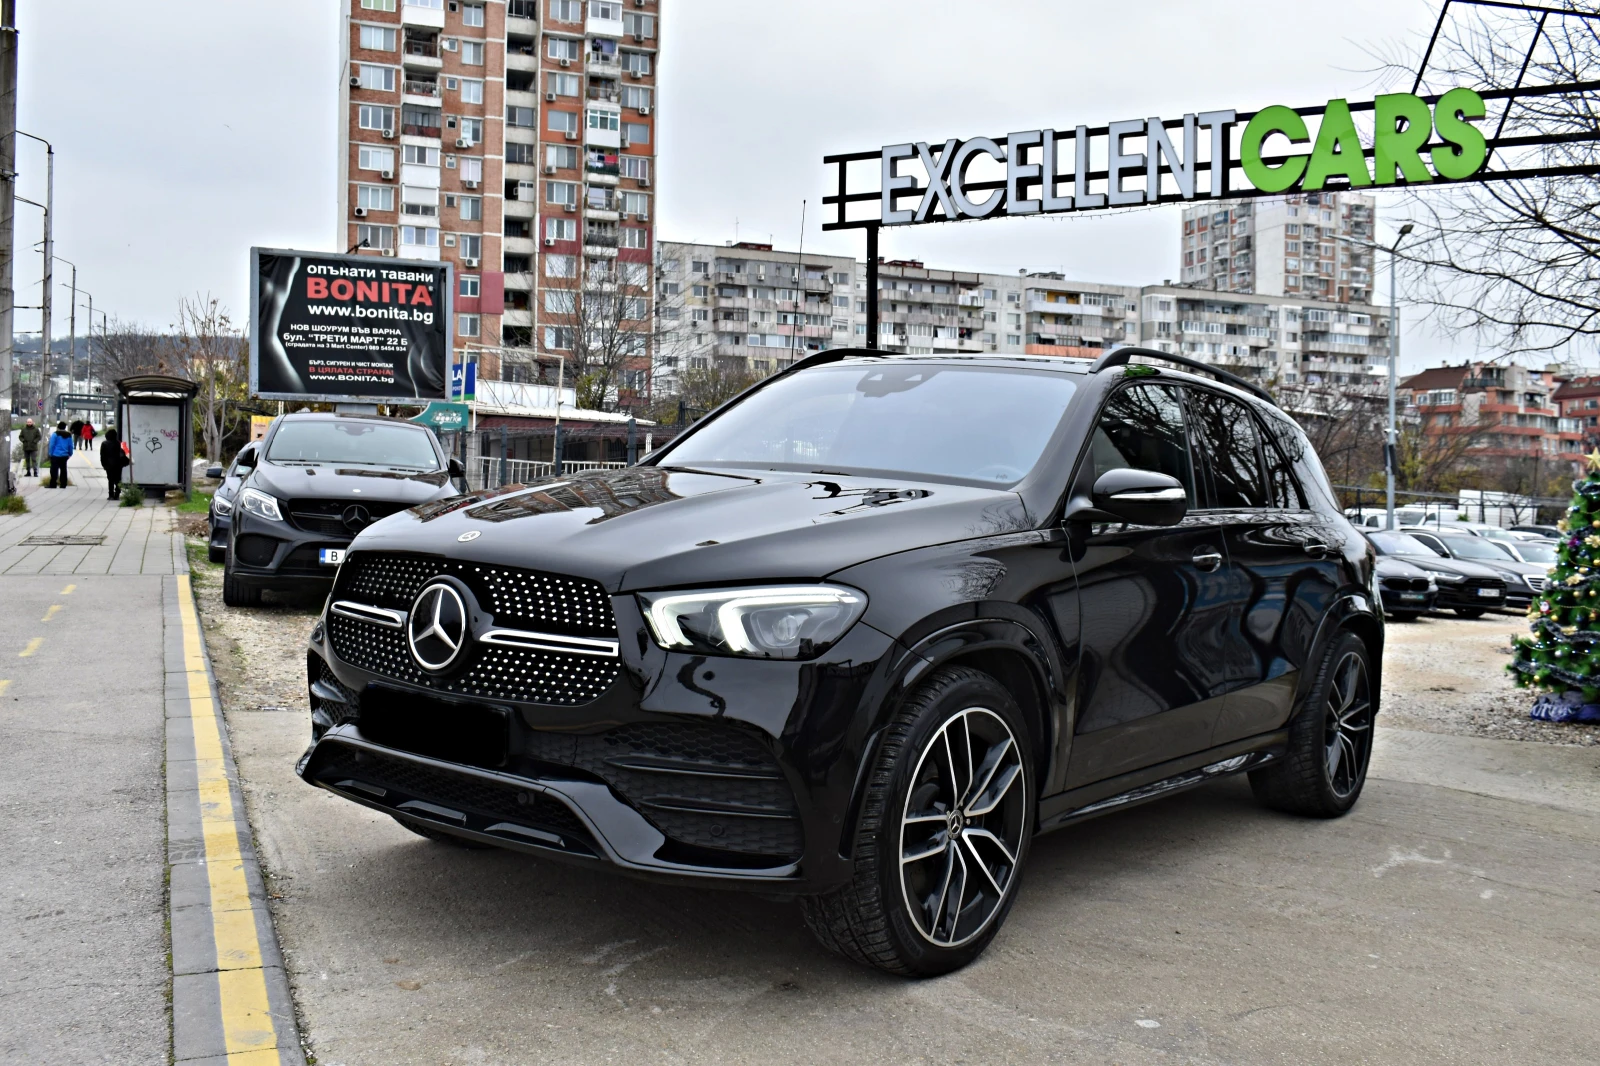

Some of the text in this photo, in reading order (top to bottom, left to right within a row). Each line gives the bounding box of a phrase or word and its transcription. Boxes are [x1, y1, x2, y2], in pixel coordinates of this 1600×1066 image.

[881, 87, 1487, 225] EXCELLENT CARS
[307, 265, 433, 282] опънати тавани
[307, 277, 433, 306] BONITA
[308, 304, 433, 324] www.bonita.bg
[312, 325, 349, 333] ШОУРУМ
[352, 326, 370, 334] ВЪВ
[372, 327, 401, 335] ВАРНА
[283, 333, 305, 342] бул.
[386, 337, 398, 345] 22
[401, 338, 408, 346] Б
[310, 374, 394, 383] www.BONITA.bg
[356, 368, 394, 376] СТРАНА!
[331, 551, 338, 561] B
